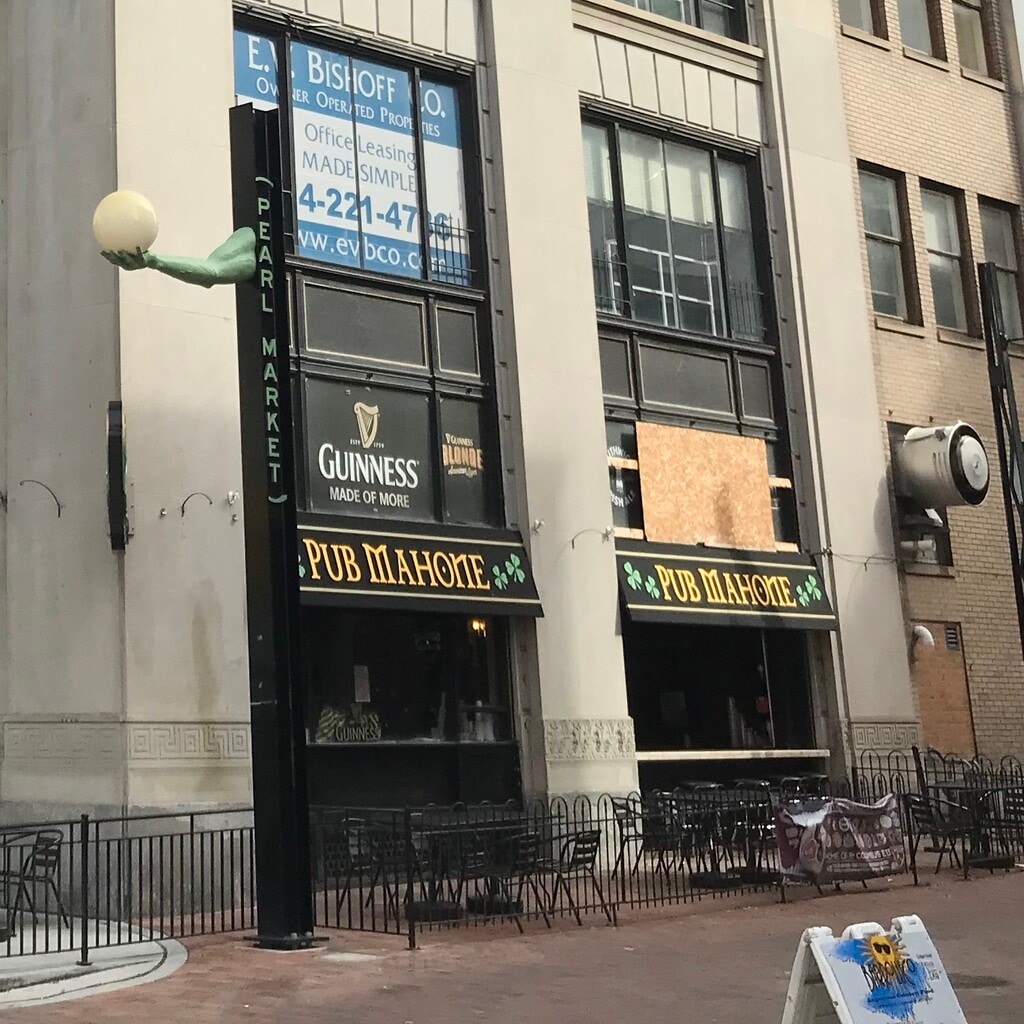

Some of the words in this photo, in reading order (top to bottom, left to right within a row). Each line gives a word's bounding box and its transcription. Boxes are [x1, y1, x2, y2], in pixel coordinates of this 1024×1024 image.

[307, 50, 396, 104] BISHOFF
[380, 107, 441, 138] PROPETIES
[304, 123, 353, 150] Office
[358, 135, 416, 171] Leasing
[302, 151, 354, 178] MADE
[360, 164, 417, 193] SIMPLE
[257, 197, 273, 313] PEARL
[262, 337, 280, 483] MARKET
[318, 443, 419, 488] GUINNESS
[442, 444, 484, 471] BLONDE
[329, 486, 361, 503] MADE
[363, 490, 376, 504] OF
[379, 492, 410, 508] MORE
[302, 538, 362, 583] PUB
[362, 542, 491, 590] MAHONE
[654, 564, 702, 604] PUB
[697, 567, 798, 608] MAHONE
